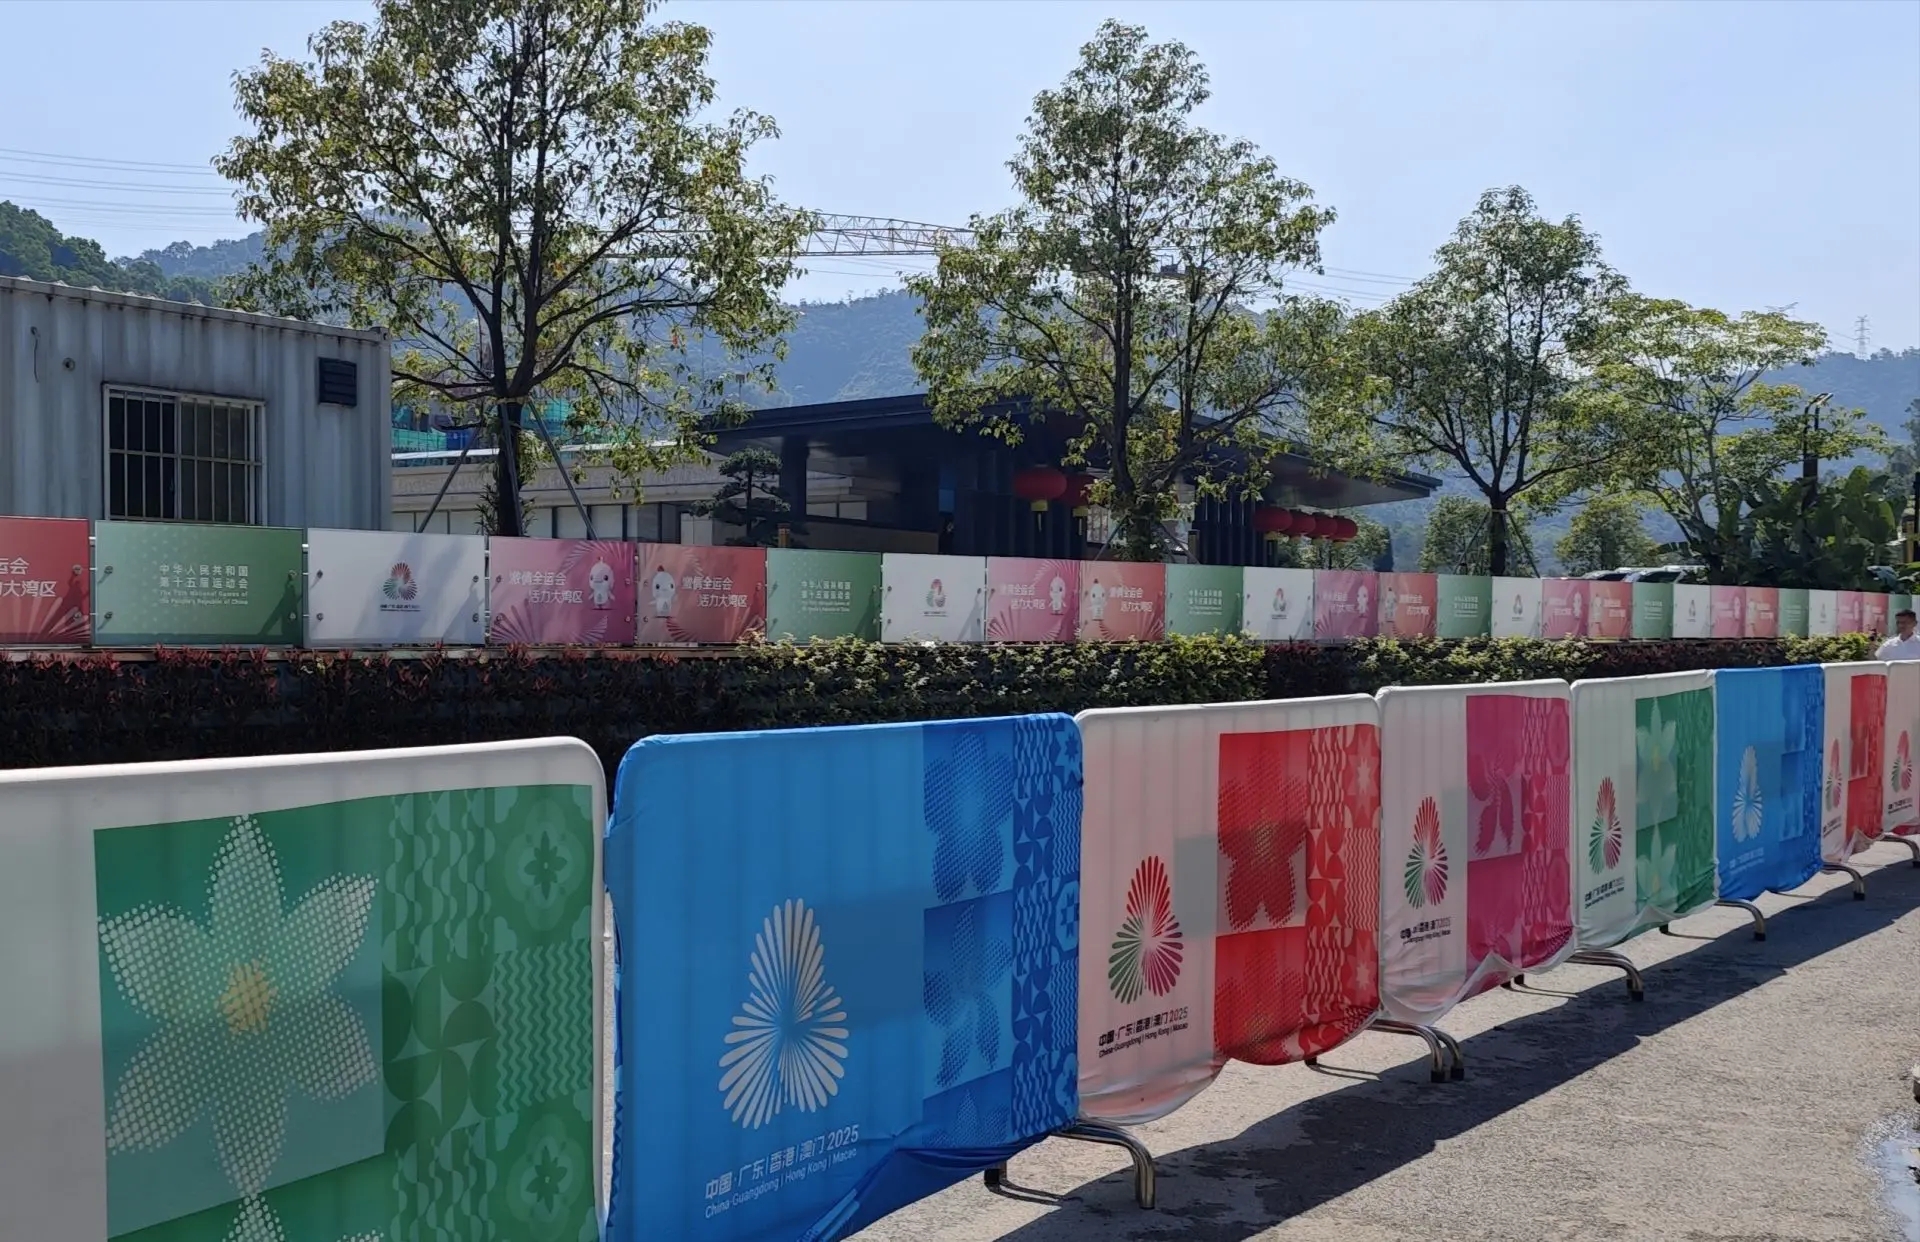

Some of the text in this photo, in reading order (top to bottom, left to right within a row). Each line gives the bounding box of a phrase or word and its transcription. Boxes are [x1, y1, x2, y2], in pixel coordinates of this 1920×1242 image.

[160, 564, 249, 578] 中华人民共和国
[0, 580, 57, 598] 大湾区
[827, 1124, 860, 1151] 2025
[784, 1167, 806, 1183] Hong
[807, 1157, 828, 1174] Kong
[832, 1147, 857, 1165] Macao
